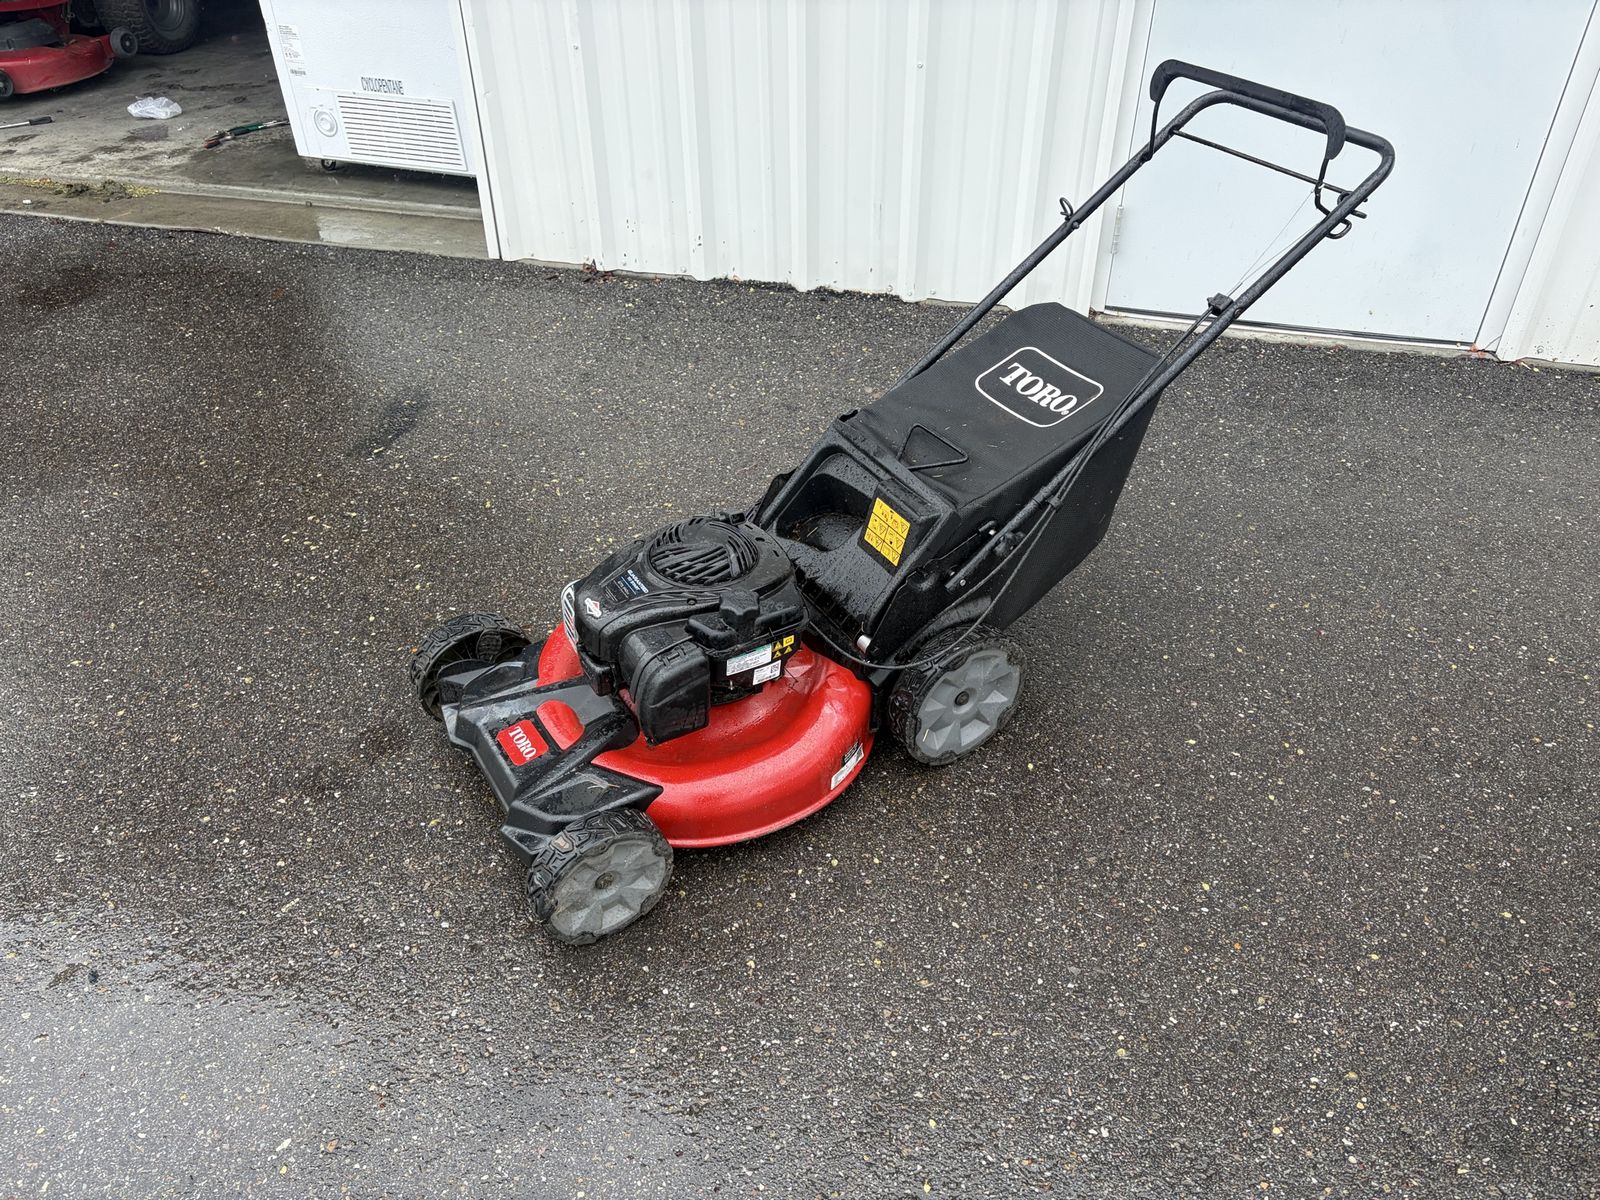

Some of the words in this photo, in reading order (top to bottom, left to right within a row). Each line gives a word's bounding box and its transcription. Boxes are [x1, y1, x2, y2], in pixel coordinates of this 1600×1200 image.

[361, 76, 404, 95] CYCLOPENTANE
[999, 362, 1077, 413] TORO
[508, 726, 537, 759] TORO
